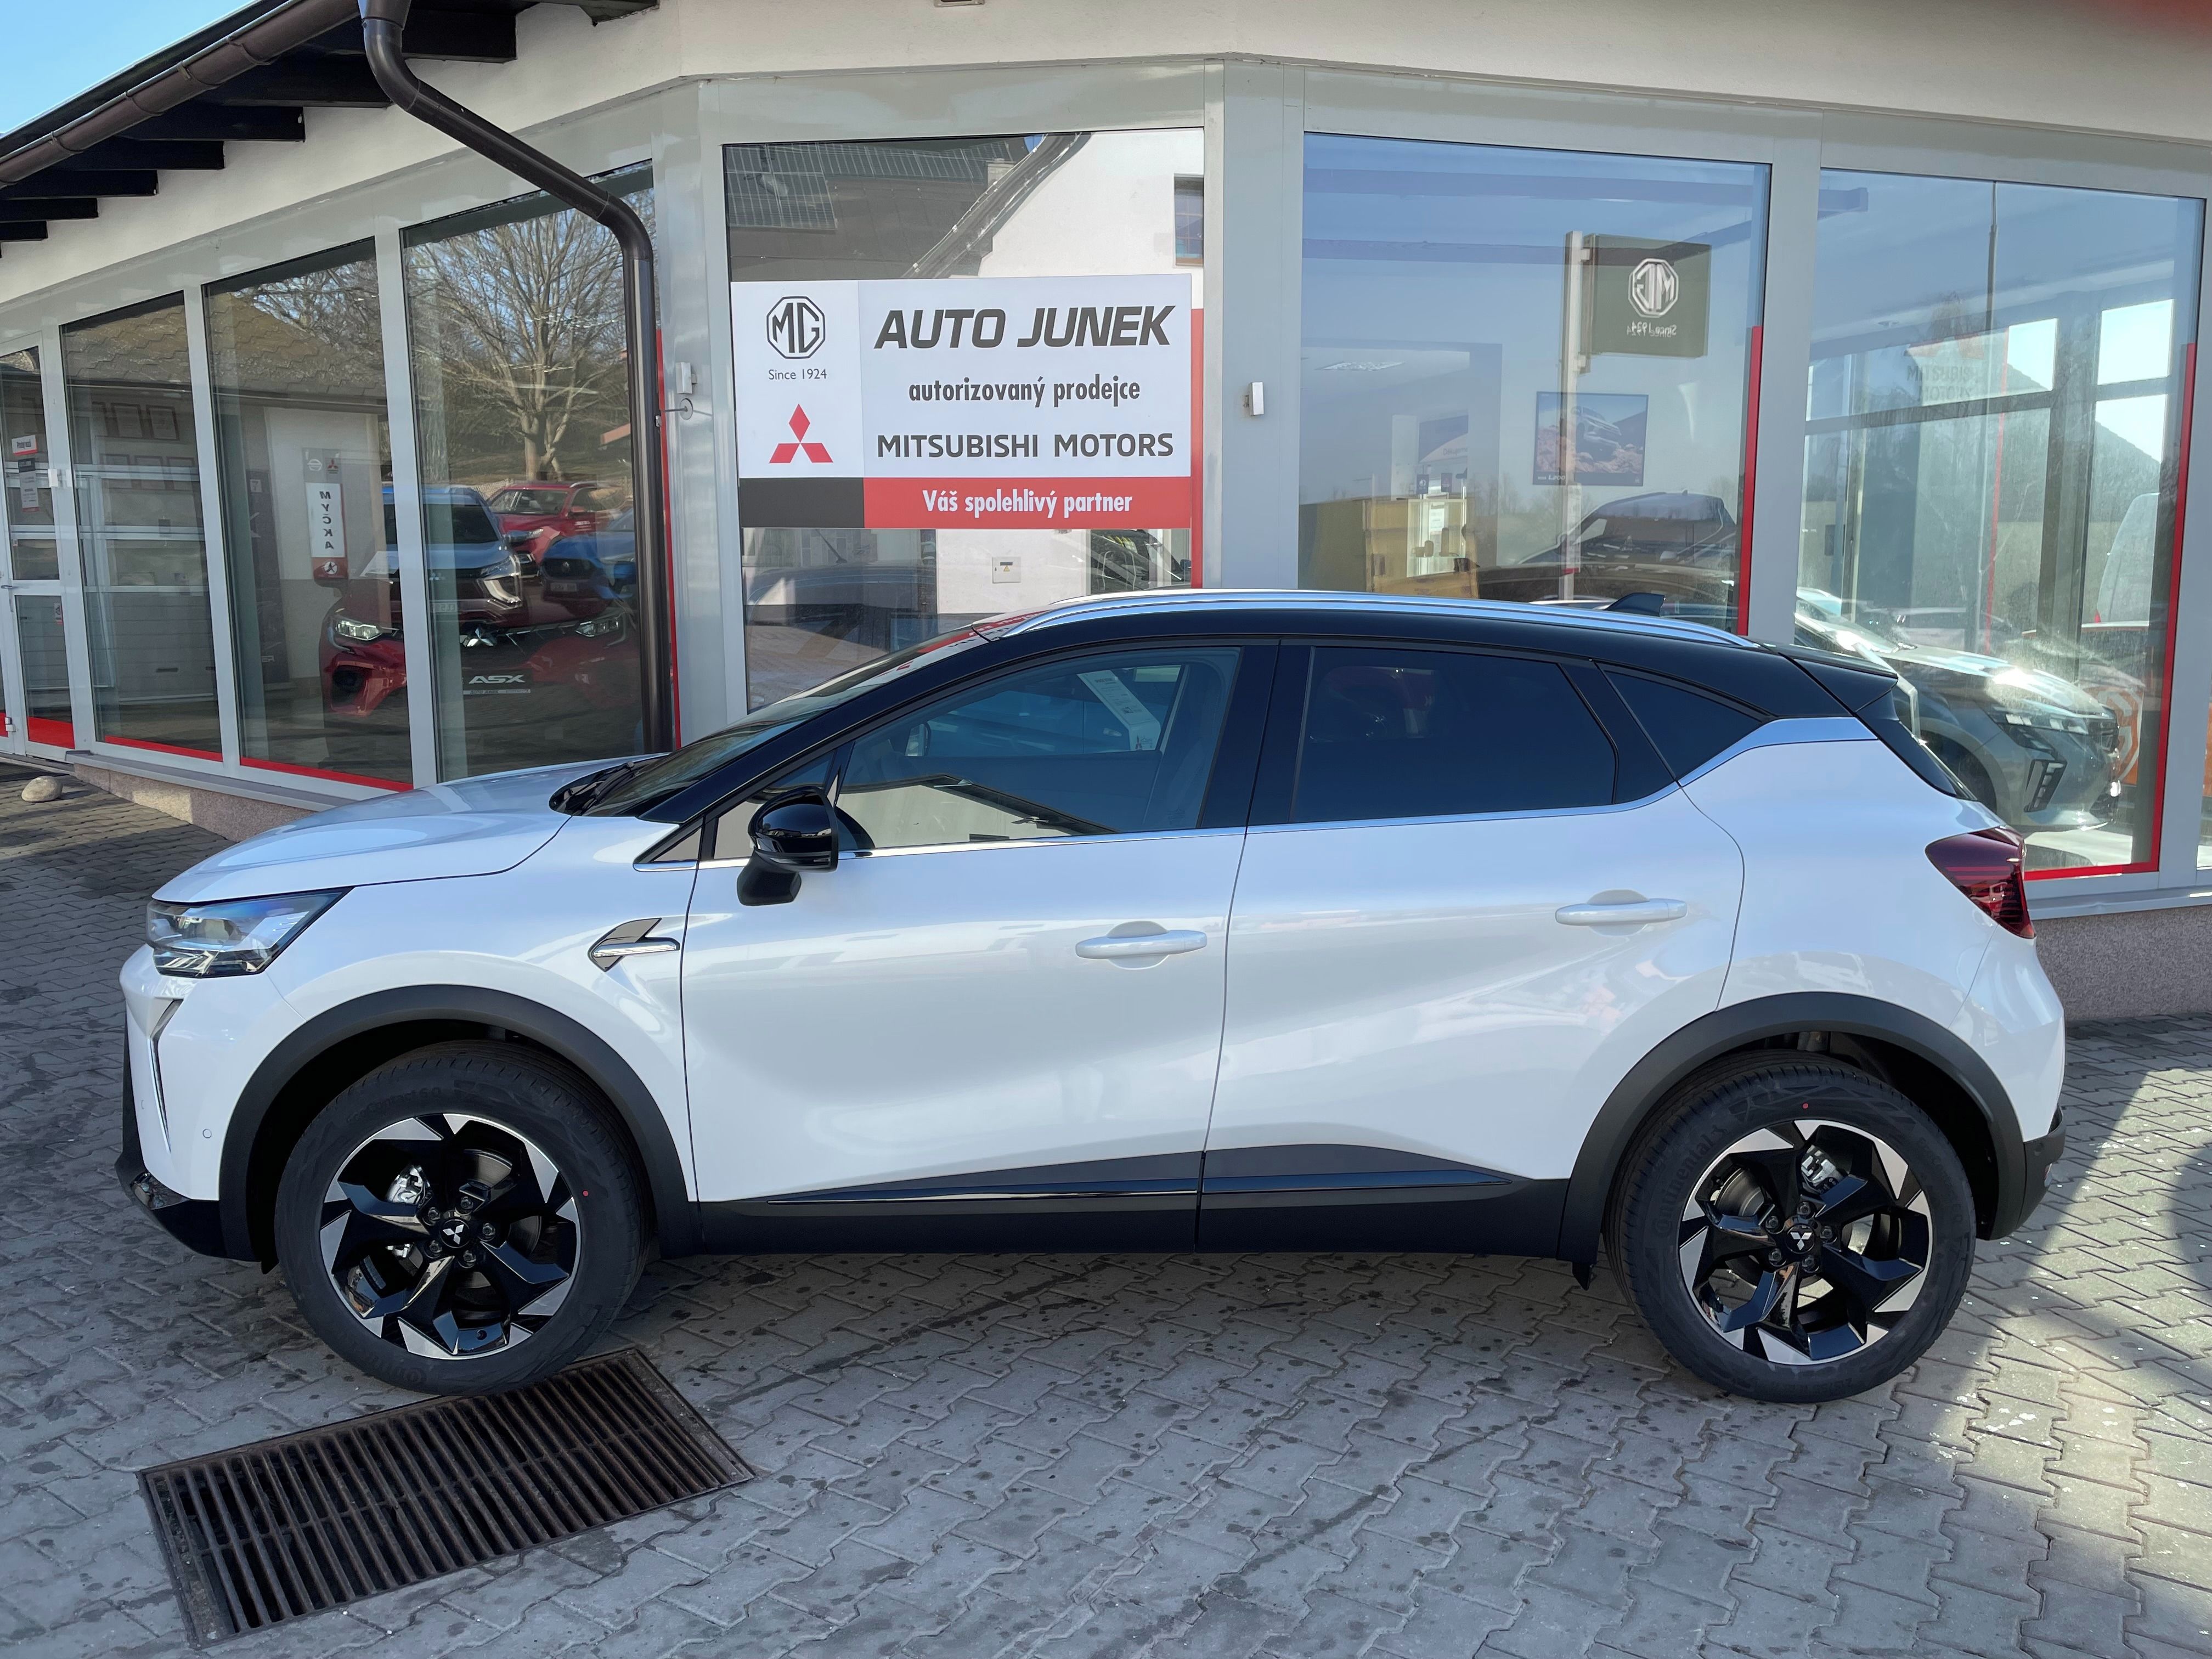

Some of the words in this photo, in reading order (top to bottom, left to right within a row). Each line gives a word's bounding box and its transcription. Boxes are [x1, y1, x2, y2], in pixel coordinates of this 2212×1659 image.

[772, 302, 820, 353] MG
[873, 309, 1006, 349] AUTO
[1017, 305, 1176, 347] JUNEK
[768, 369, 797, 380] Since
[802, 368, 827, 380] 1924
[909, 376, 1044, 408] autorizovaný
[1053, 373, 1141, 408] prodejce
[877, 434, 1039, 458] MITSUBISHI
[1054, 433, 1173, 457] MOTORS
[922, 489, 958, 512] Váš
[964, 488, 1057, 518] spolehlivý
[1064, 493, 1133, 518] partner
[469, 675, 526, 684] ASX
